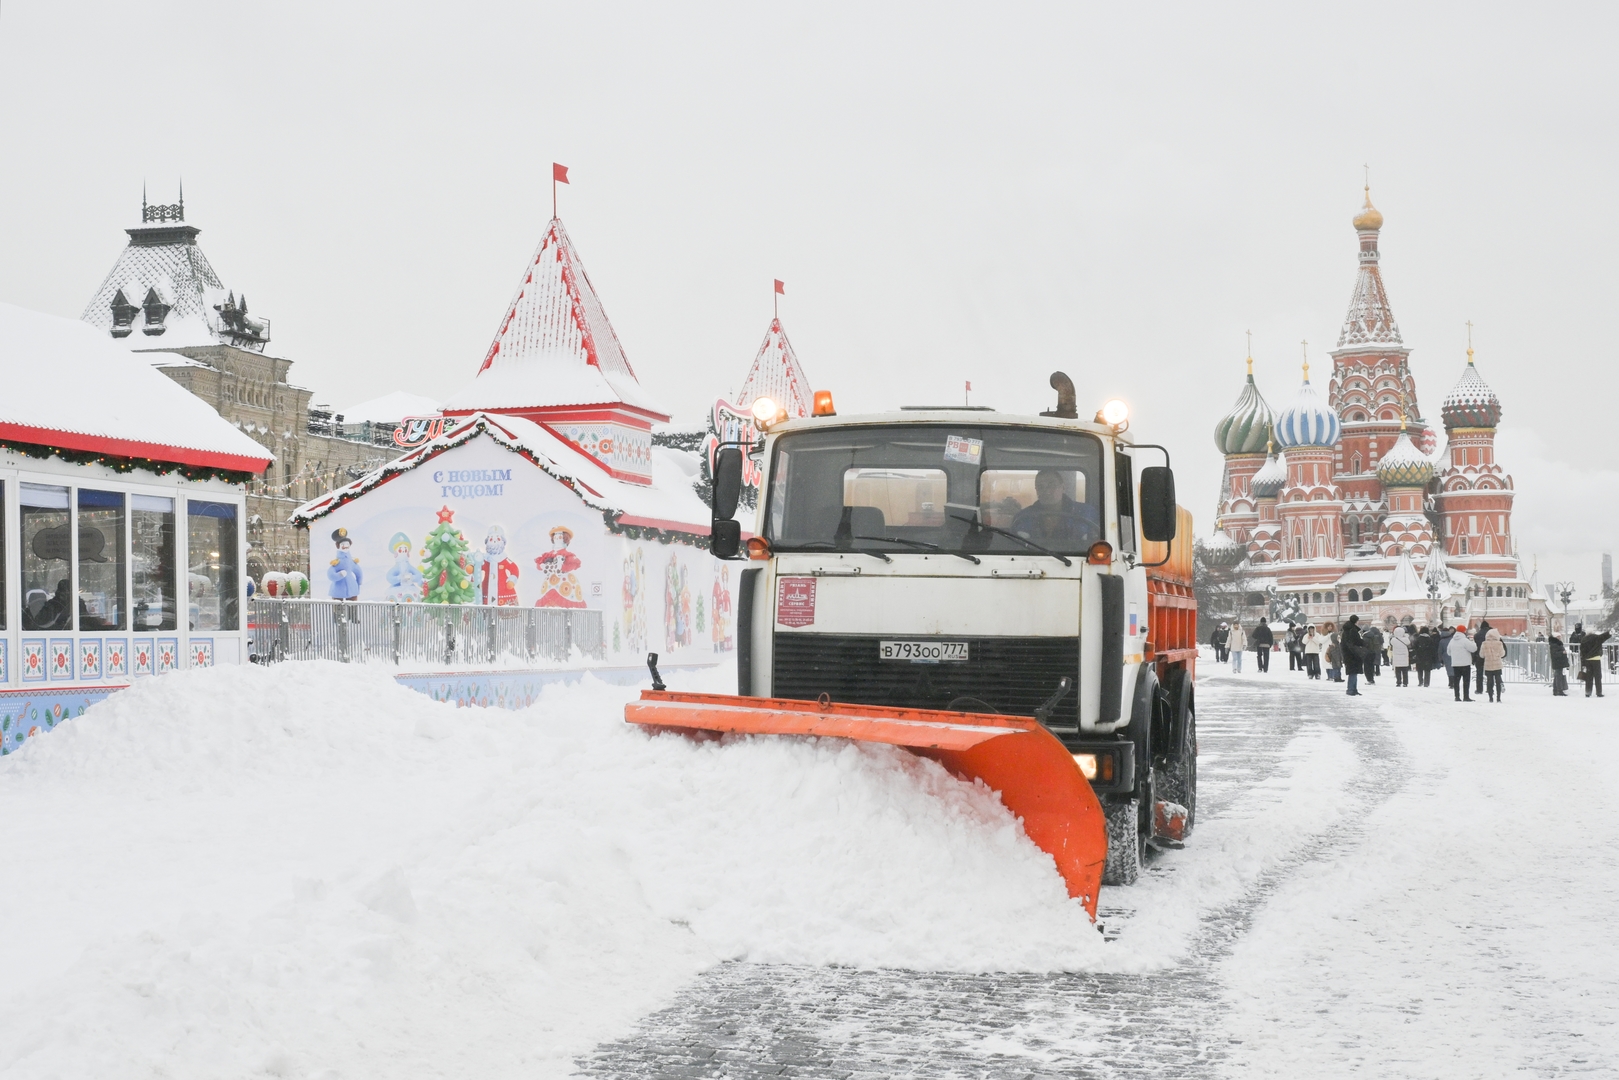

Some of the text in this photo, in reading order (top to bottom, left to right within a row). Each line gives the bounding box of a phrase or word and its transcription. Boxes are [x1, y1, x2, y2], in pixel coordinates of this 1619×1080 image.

[433, 469, 512, 483] С НОВЫМ
[441, 484, 504, 499] ГОДОМ!
[942, 643, 964, 655] 777
